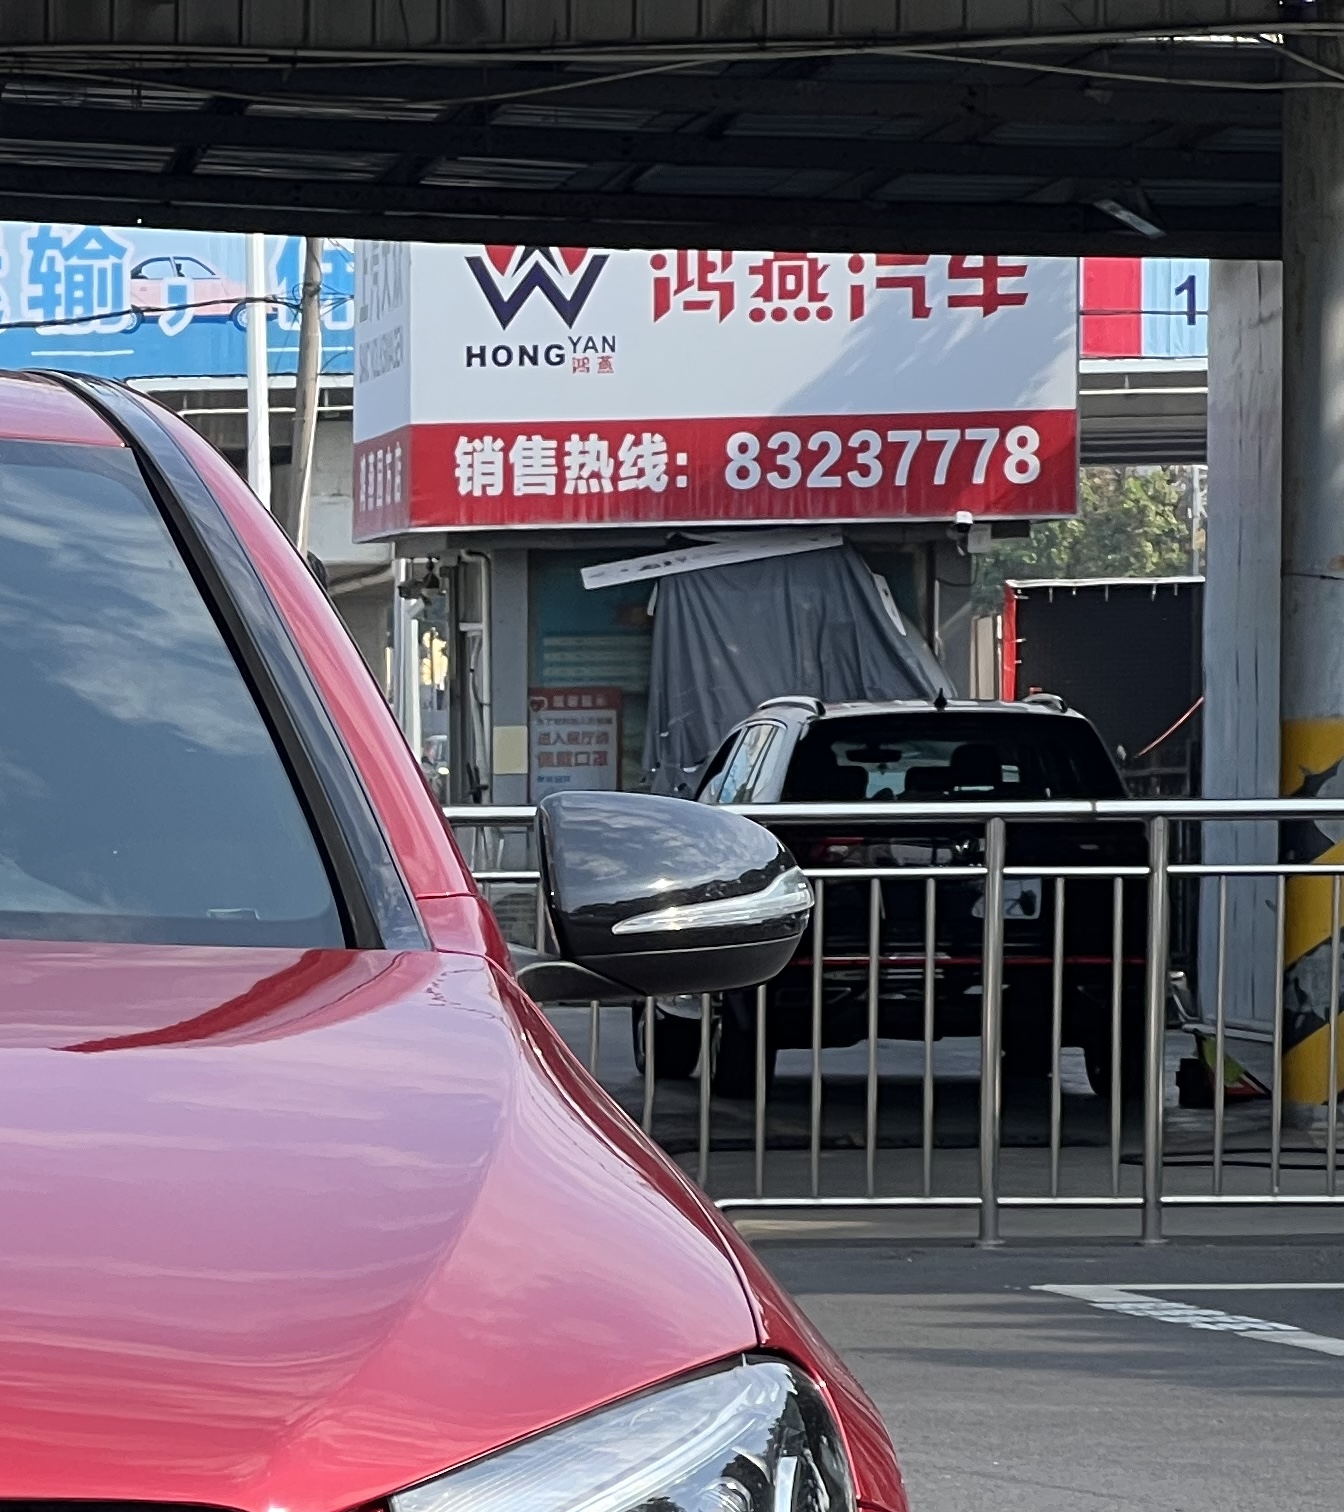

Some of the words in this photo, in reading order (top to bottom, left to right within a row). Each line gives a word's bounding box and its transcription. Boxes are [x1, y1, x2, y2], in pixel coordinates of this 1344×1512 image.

[649, 250, 1029, 324] 鸿燕汽车
[465, 344, 566, 368] HONG
[568, 335, 616, 354] YAN
[724, 424, 1042, 491] 83237778
